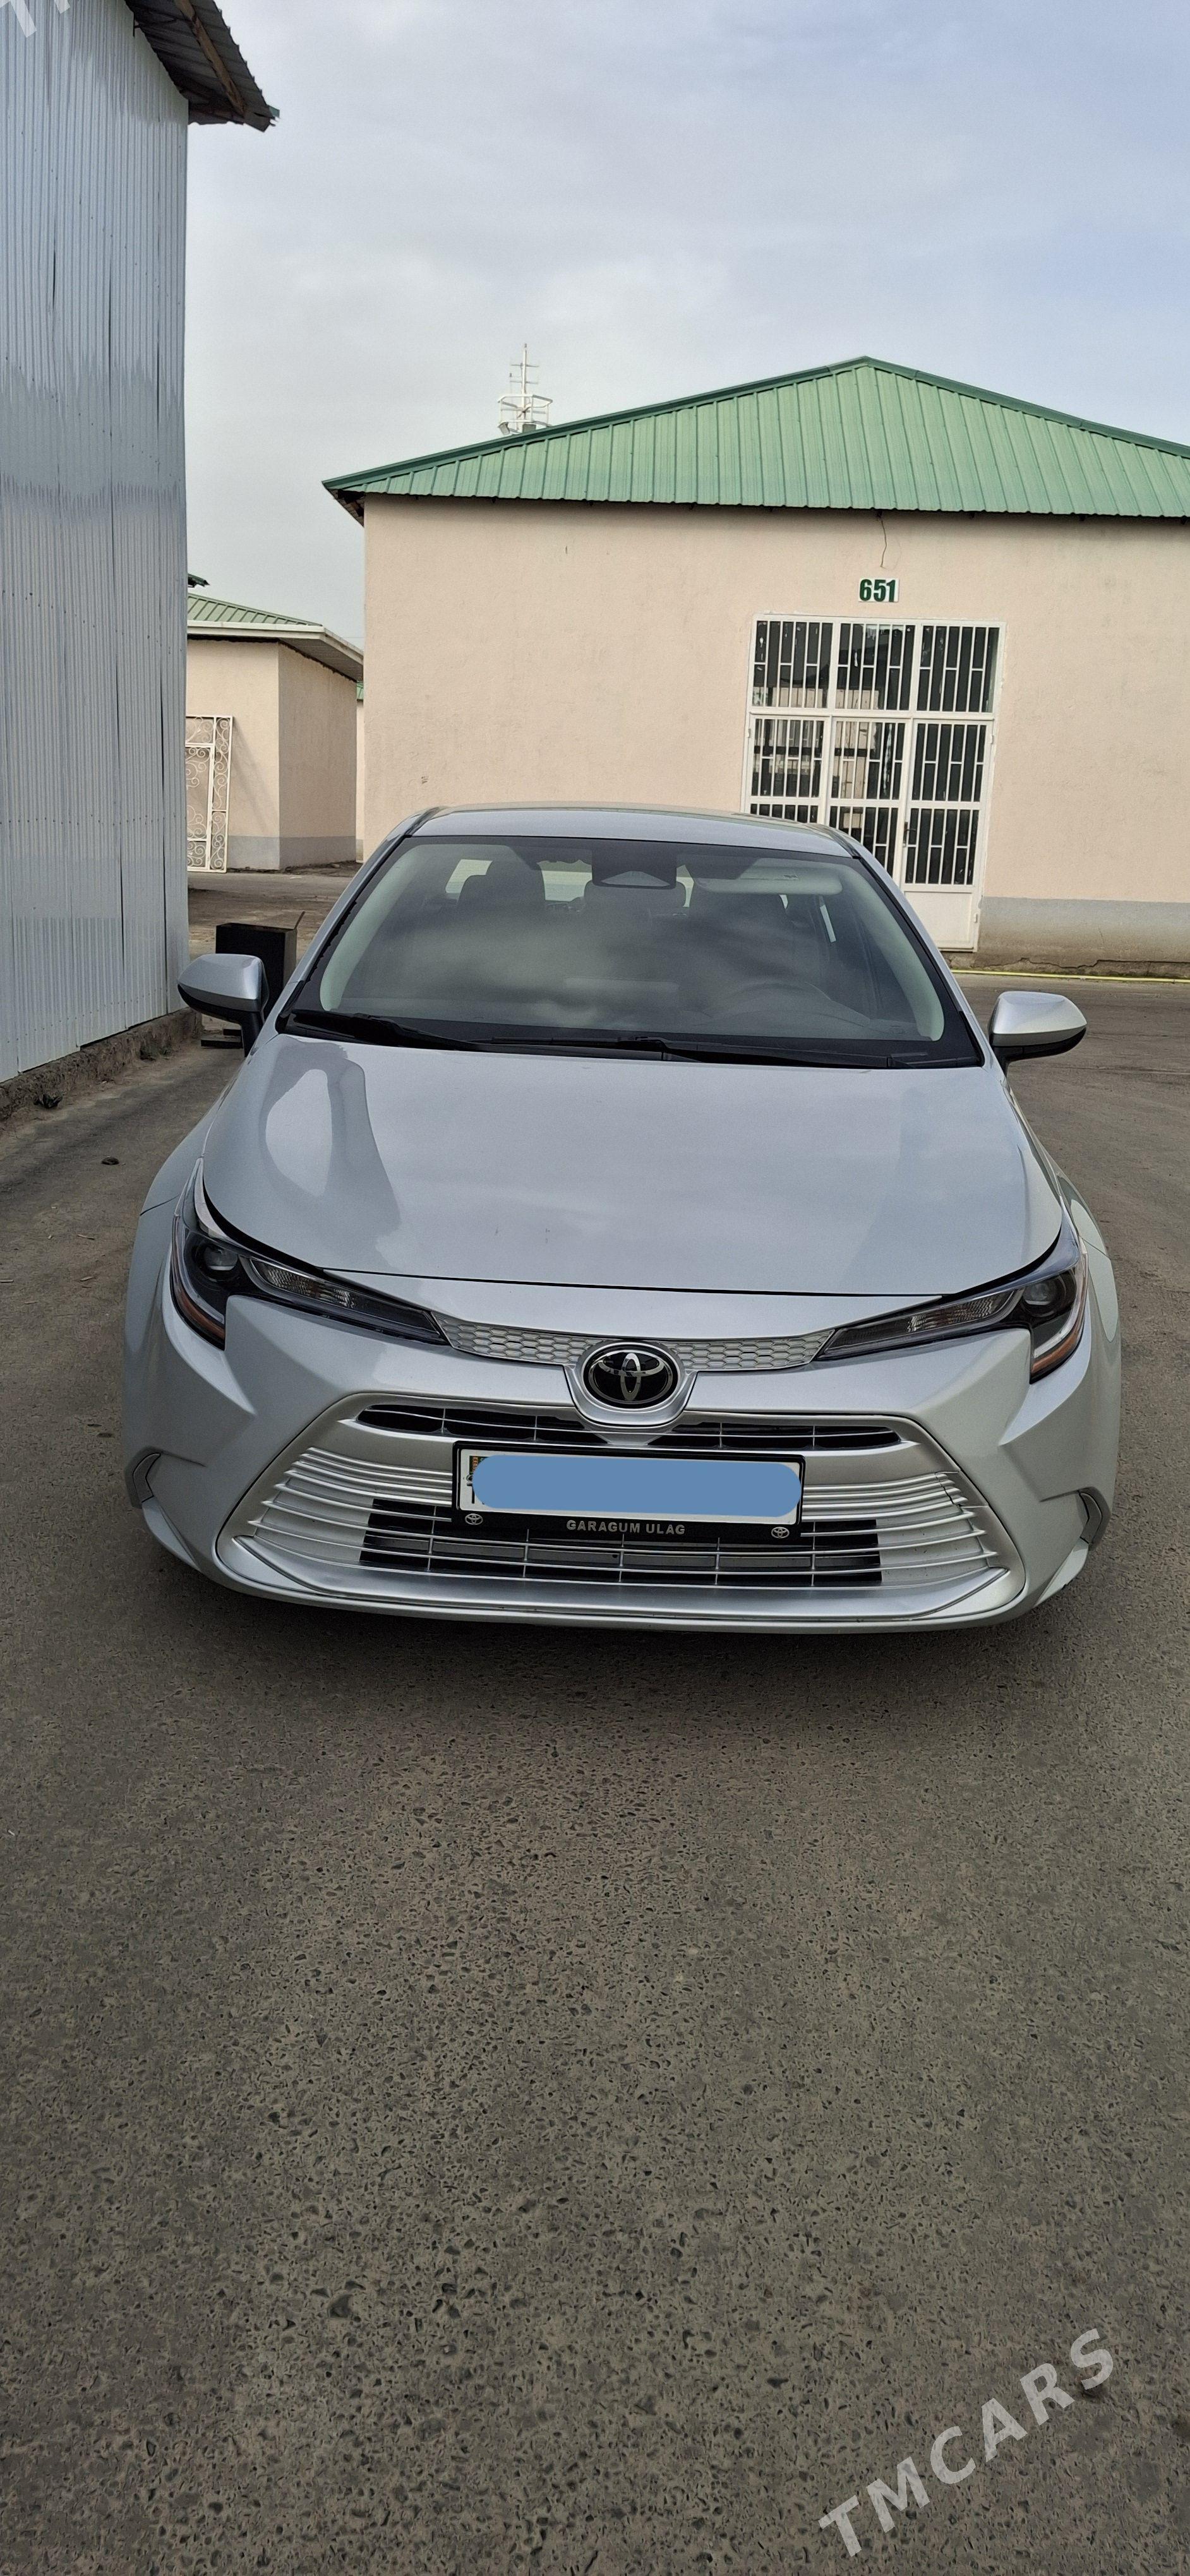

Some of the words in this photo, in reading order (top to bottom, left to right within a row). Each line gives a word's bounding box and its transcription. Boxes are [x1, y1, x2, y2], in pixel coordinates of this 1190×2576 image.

[859, 578, 896, 602] 651
[566, 1520, 640, 1533] GARAGUM
[646, 1524, 685, 1535] ULAG
